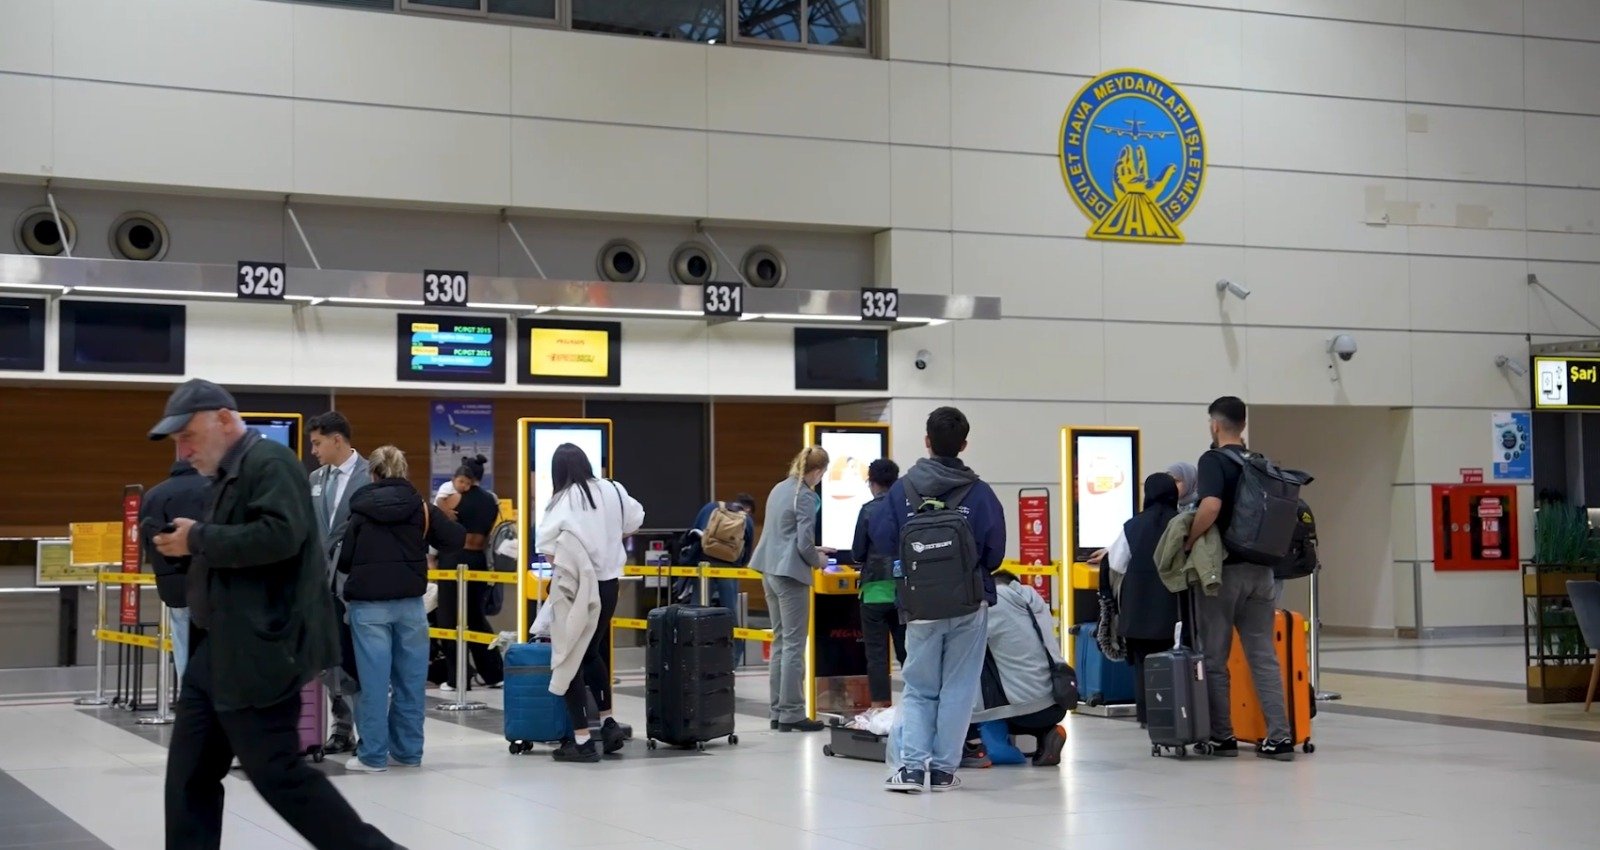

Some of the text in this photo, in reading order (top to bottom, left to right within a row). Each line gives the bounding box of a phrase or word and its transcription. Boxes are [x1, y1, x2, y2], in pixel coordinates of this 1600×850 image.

[1068, 76, 1201, 220] DEVLET HAVA MEYDANLARI İŞLETMESİ
[240, 266, 284, 295] 329
[425, 274, 466, 303] 330
[706, 285, 741, 314] 331
[863, 292, 897, 318] 332
[1570, 366, 1597, 383] Şarj
